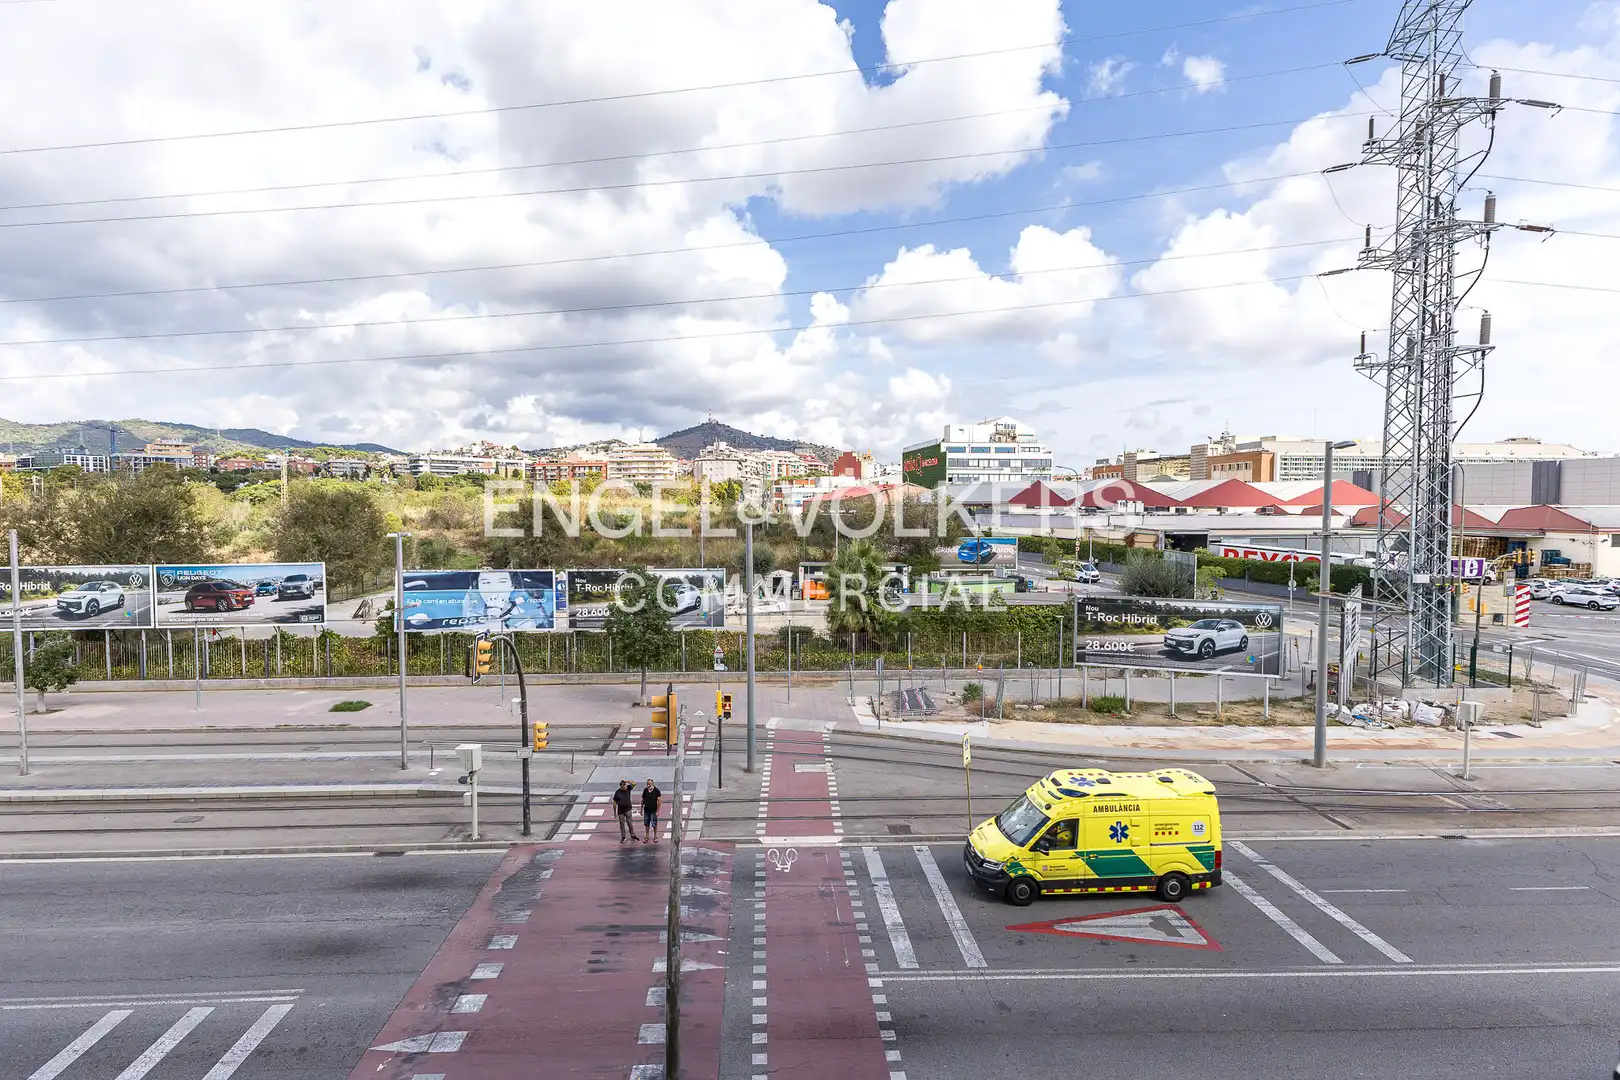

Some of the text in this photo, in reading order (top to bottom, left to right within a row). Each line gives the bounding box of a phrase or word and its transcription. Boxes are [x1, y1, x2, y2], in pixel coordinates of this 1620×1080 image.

[20, 581, 51, 590] Híbrid
[575, 583, 602, 592] T-Roc
[442, 616, 488, 626] repso
[1085, 612, 1157, 624] T-Roc Híbrid
[1085, 640, 1135, 652] 28.600€
[1093, 802, 1141, 814] AMBULÀNCIA
